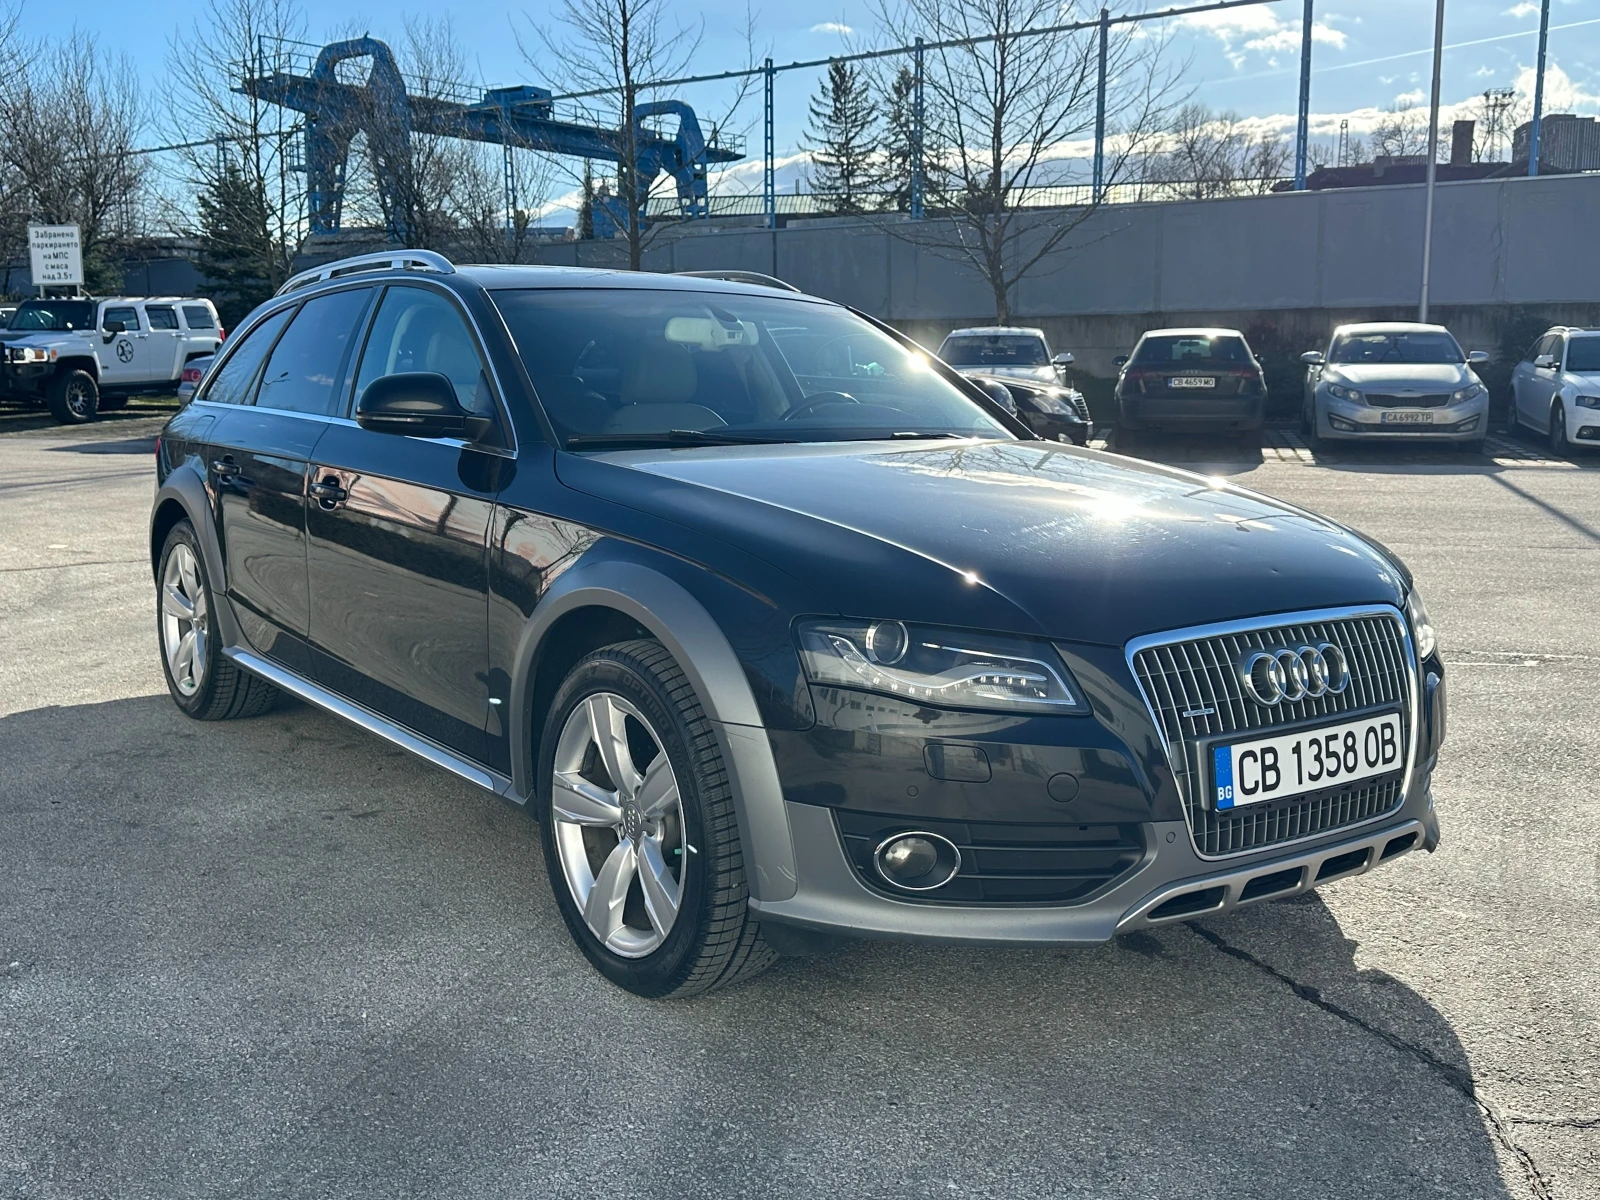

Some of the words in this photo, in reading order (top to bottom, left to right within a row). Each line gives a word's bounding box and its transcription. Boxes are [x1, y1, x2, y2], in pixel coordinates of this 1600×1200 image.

[34, 230, 75, 240] Забранено
[31, 241, 79, 250] паркирането
[42, 273, 56, 281] над
[1173, 378, 1184, 386] CB
[1184, 378, 1203, 386] 4659
[1203, 378, 1214, 386] MO
[1386, 413, 1399, 422] CA
[1399, 413, 1420, 422] 6992
[1420, 413, 1432, 422] TP
[1238, 746, 1281, 796] CB
[1291, 730, 1358, 786] 1358
[1364, 721, 1397, 769] OB
[1217, 785, 1233, 801] BG
